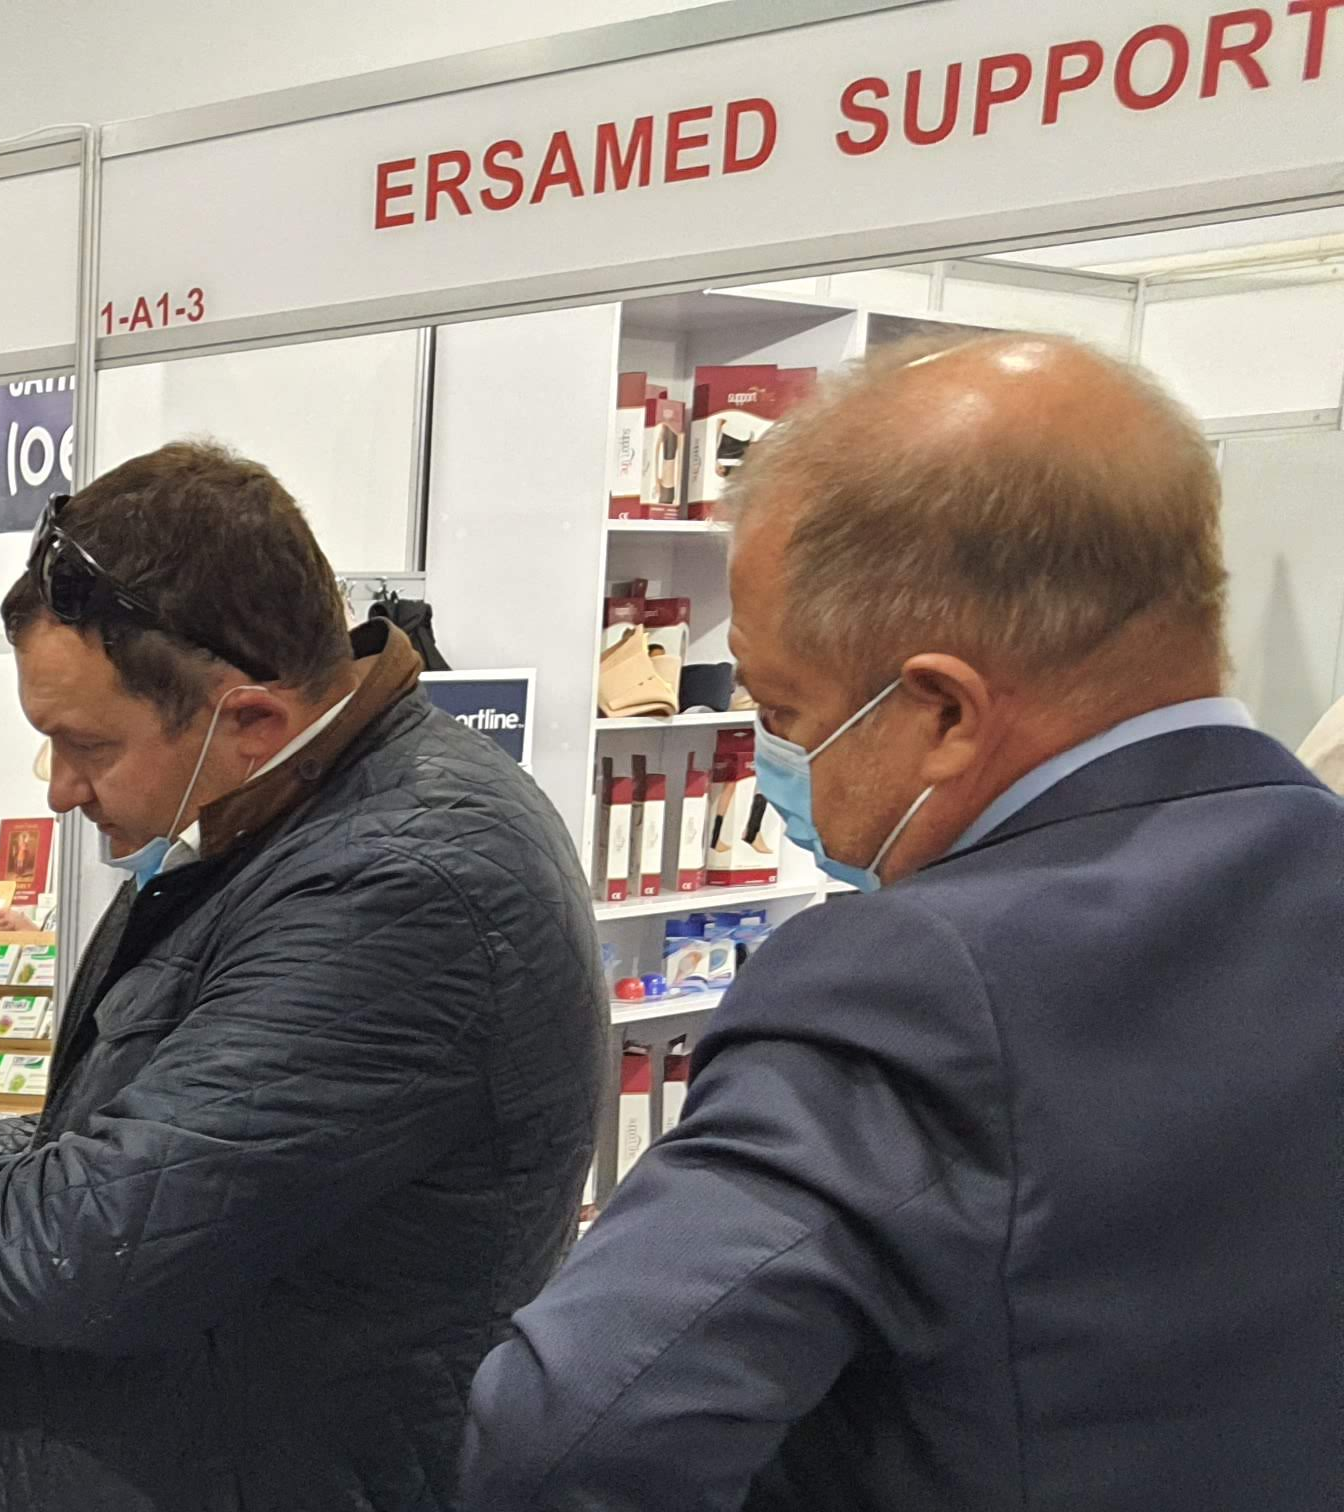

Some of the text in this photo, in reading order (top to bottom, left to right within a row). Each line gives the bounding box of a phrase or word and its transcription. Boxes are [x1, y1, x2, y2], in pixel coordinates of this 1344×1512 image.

[372, 0, 1344, 231] ERSAMED SUPPORT
[100, 286, 206, 334] 1-A1-3
